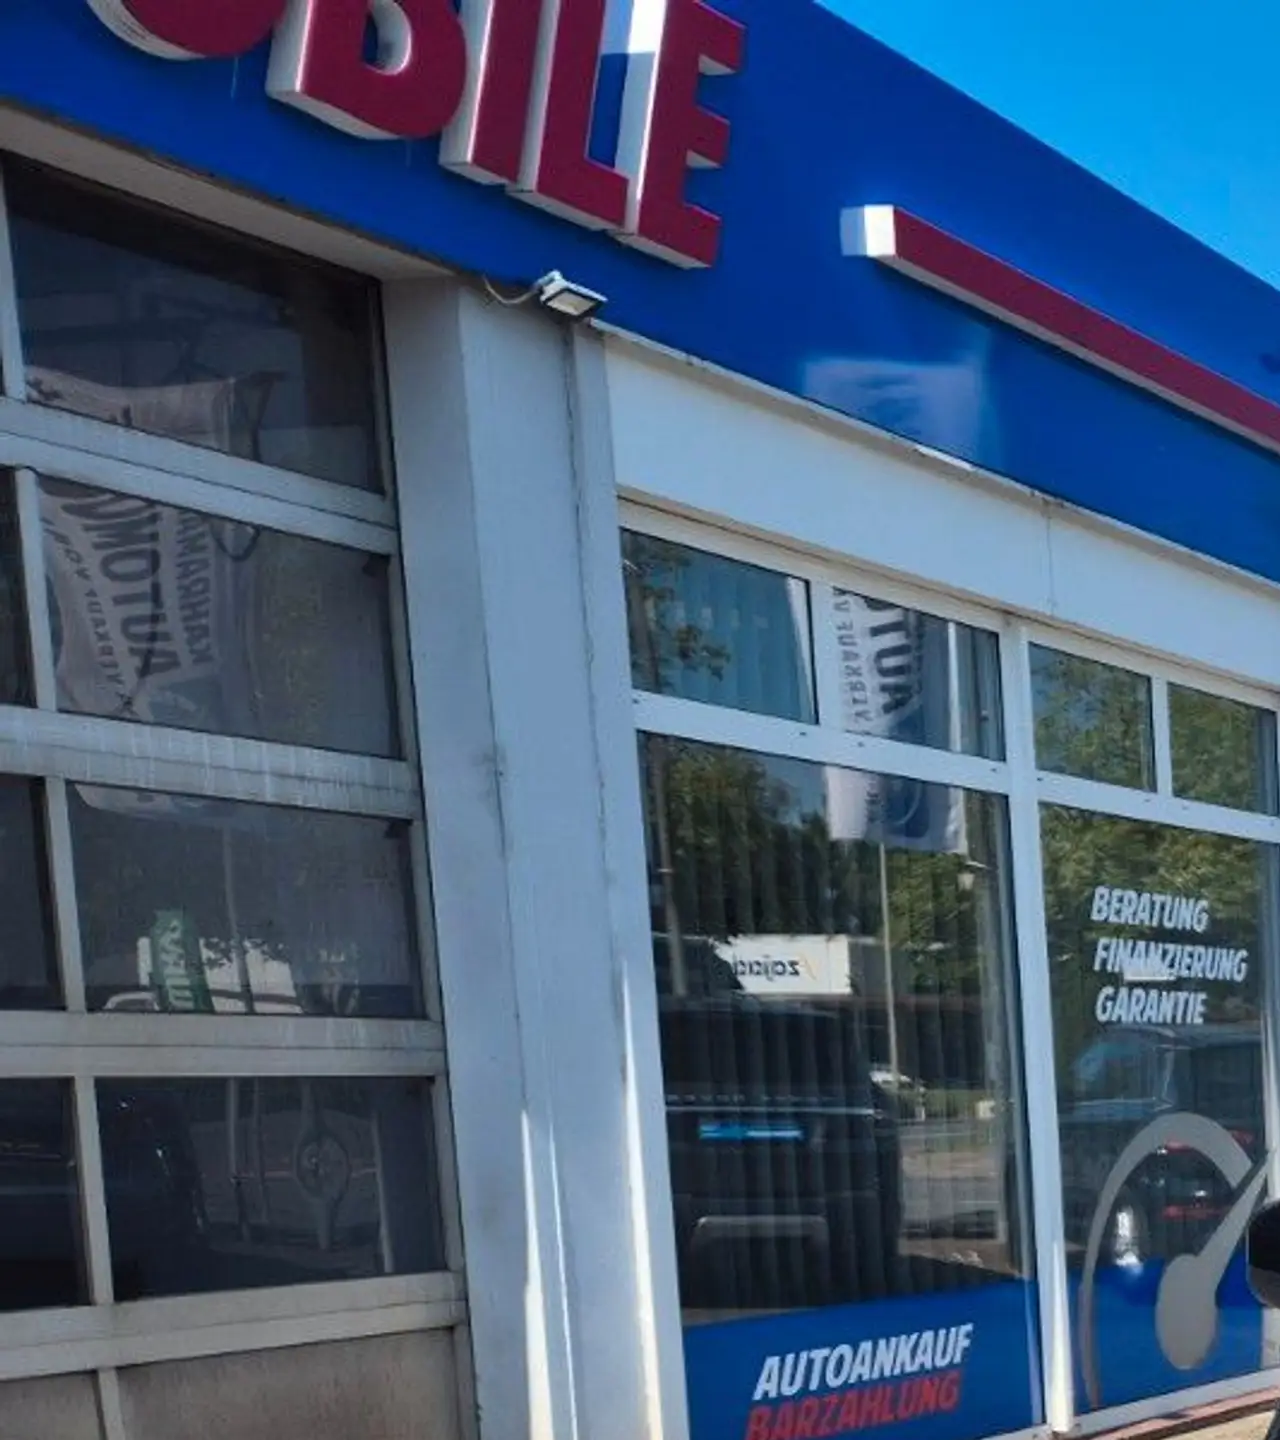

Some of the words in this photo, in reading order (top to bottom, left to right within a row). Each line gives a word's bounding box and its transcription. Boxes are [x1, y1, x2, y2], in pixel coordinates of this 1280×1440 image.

[1091, 885, 1209, 932] BERATUNG
[1093, 937, 1249, 982] FINANZIERUNG
[1095, 985, 1208, 1025] GARANTIE
[752, 1322, 974, 1401] AUTOANKAUF
